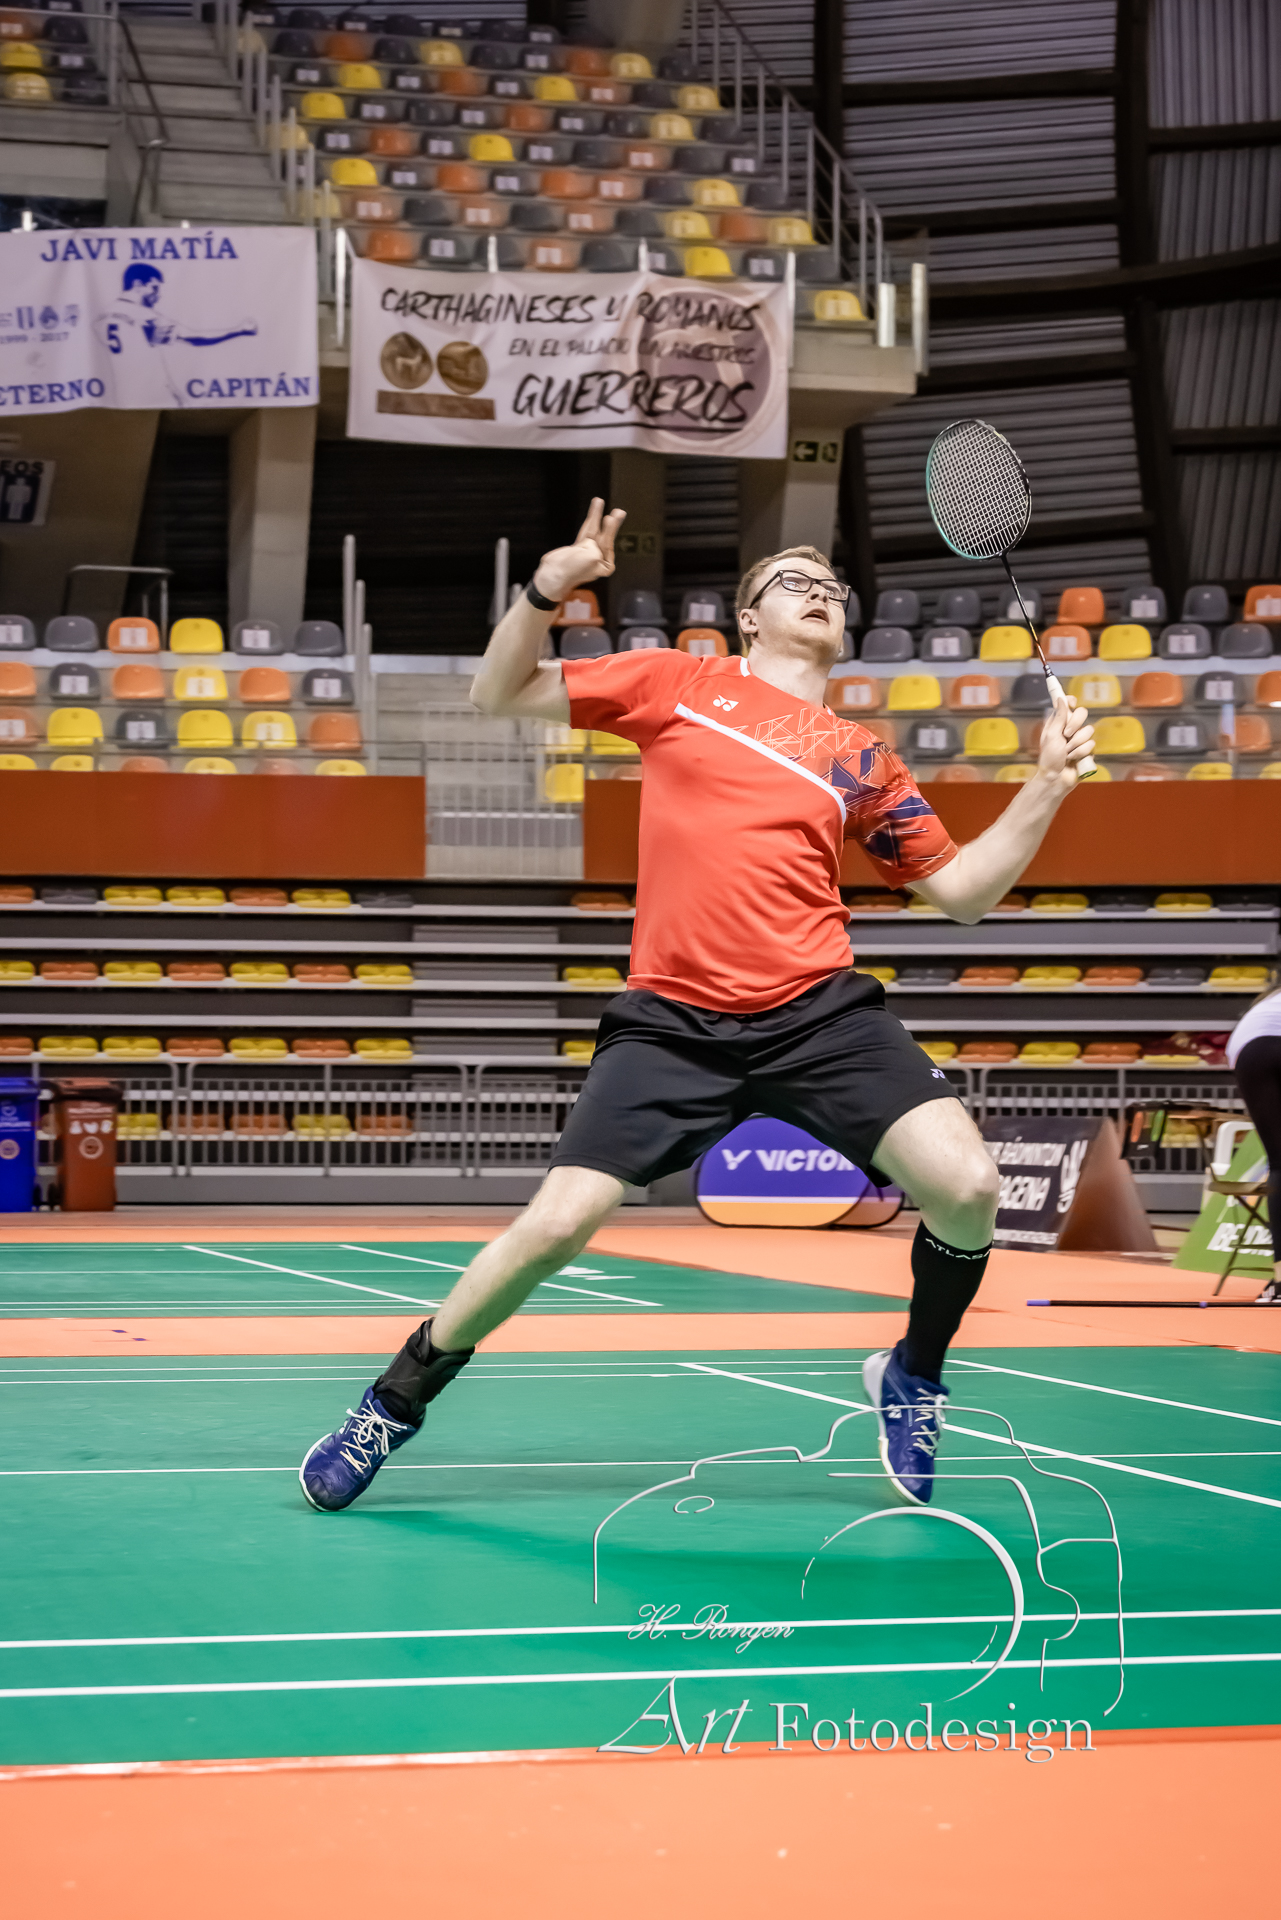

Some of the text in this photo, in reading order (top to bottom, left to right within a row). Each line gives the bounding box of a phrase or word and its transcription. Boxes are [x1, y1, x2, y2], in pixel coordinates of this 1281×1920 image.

[41, 231, 239, 262] JAVI MATÍA
[381, 287, 597, 325] CARTHAGINESES
[107, 323, 123, 354] 5
[508, 338, 534, 357] EN
[539, 338, 561, 357] EL
[186, 372, 311, 399] CAPITÁN
[512, 370, 756, 423] GUERREROS
